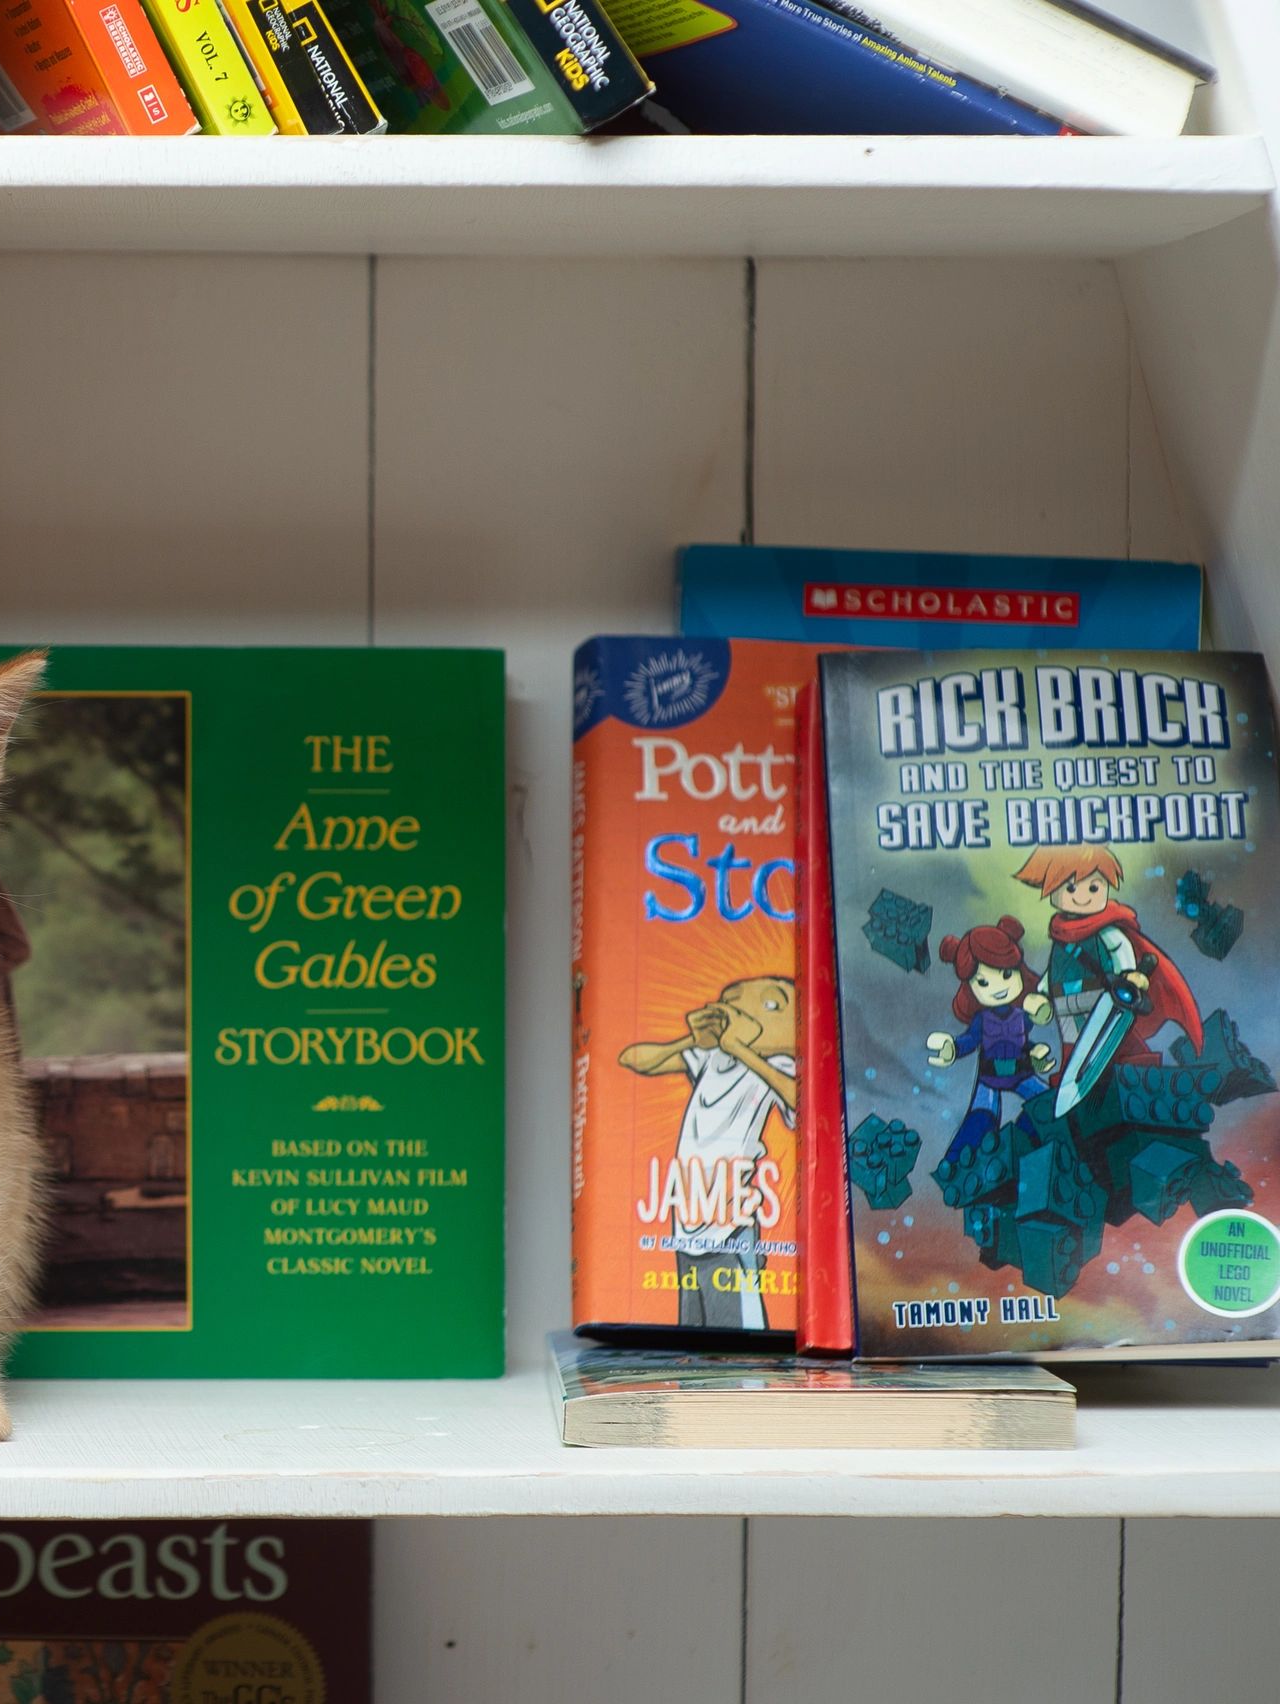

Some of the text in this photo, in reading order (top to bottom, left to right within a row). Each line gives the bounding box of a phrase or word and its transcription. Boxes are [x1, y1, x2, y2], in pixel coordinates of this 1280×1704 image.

[273, 7, 292, 40] NATIONAL
[563, 0, 611, 65] NATIONAL
[108, 23, 137, 76] REFERENCE
[116, 20, 144, 71] SCHOLASTIC
[196, 30, 229, 81] VOL. 7
[549, 7, 610, 92] GEOGRAPHIC
[802, 7, 823, 22] True
[822, 17, 852, 38] Stories
[852, 32, 863, 43] of
[862, 36, 898, 60] Amazing
[896, 53, 927, 74] Animal
[927, 66, 957, 88] Talents
[307, 45, 348, 109] NATIONAL
[843, 588, 1073, 620] SCHOLASTIC
[876, 665, 1231, 757] RICK BRICK
[304, 735, 394, 773] THE
[632, 737, 795, 801] Pott
[900, 756, 1216, 794] AND THE QUEST TO
[274, 801, 420, 851] Anne
[718, 804, 785, 835] and
[877, 792, 1248, 850] SAVE BRICKPORT
[228, 871, 462, 933] of Green
[255, 939, 437, 989] Gables
[214, 1027, 486, 1066] STORYBOOK
[272, 1139, 429, 1157] BASED ON THE
[232, 1169, 467, 1186] KEVIN SULLIVAN FILM
[637, 1157, 781, 1228] JAMES
[271, 1198, 429, 1216] OF LUCY MAUD
[263, 1227, 437, 1245] MONTGOMERY'S
[640, 1235, 656, 1249] #1
[661, 1236, 750, 1254] BESTSELLING
[1228, 1222, 1245, 1237] AN
[267, 1257, 432, 1275] CLASSIC NOVEL
[1200, 1241, 1271, 1260] UNOFFICIAL
[642, 1266, 700, 1292] and
[1219, 1264, 1250, 1280] LEGO
[892, 1295, 1060, 1329] TAMONY HALL
[1214, 1286, 1254, 1302] NOVEL
[202, 1660, 294, 1678] WINNER
